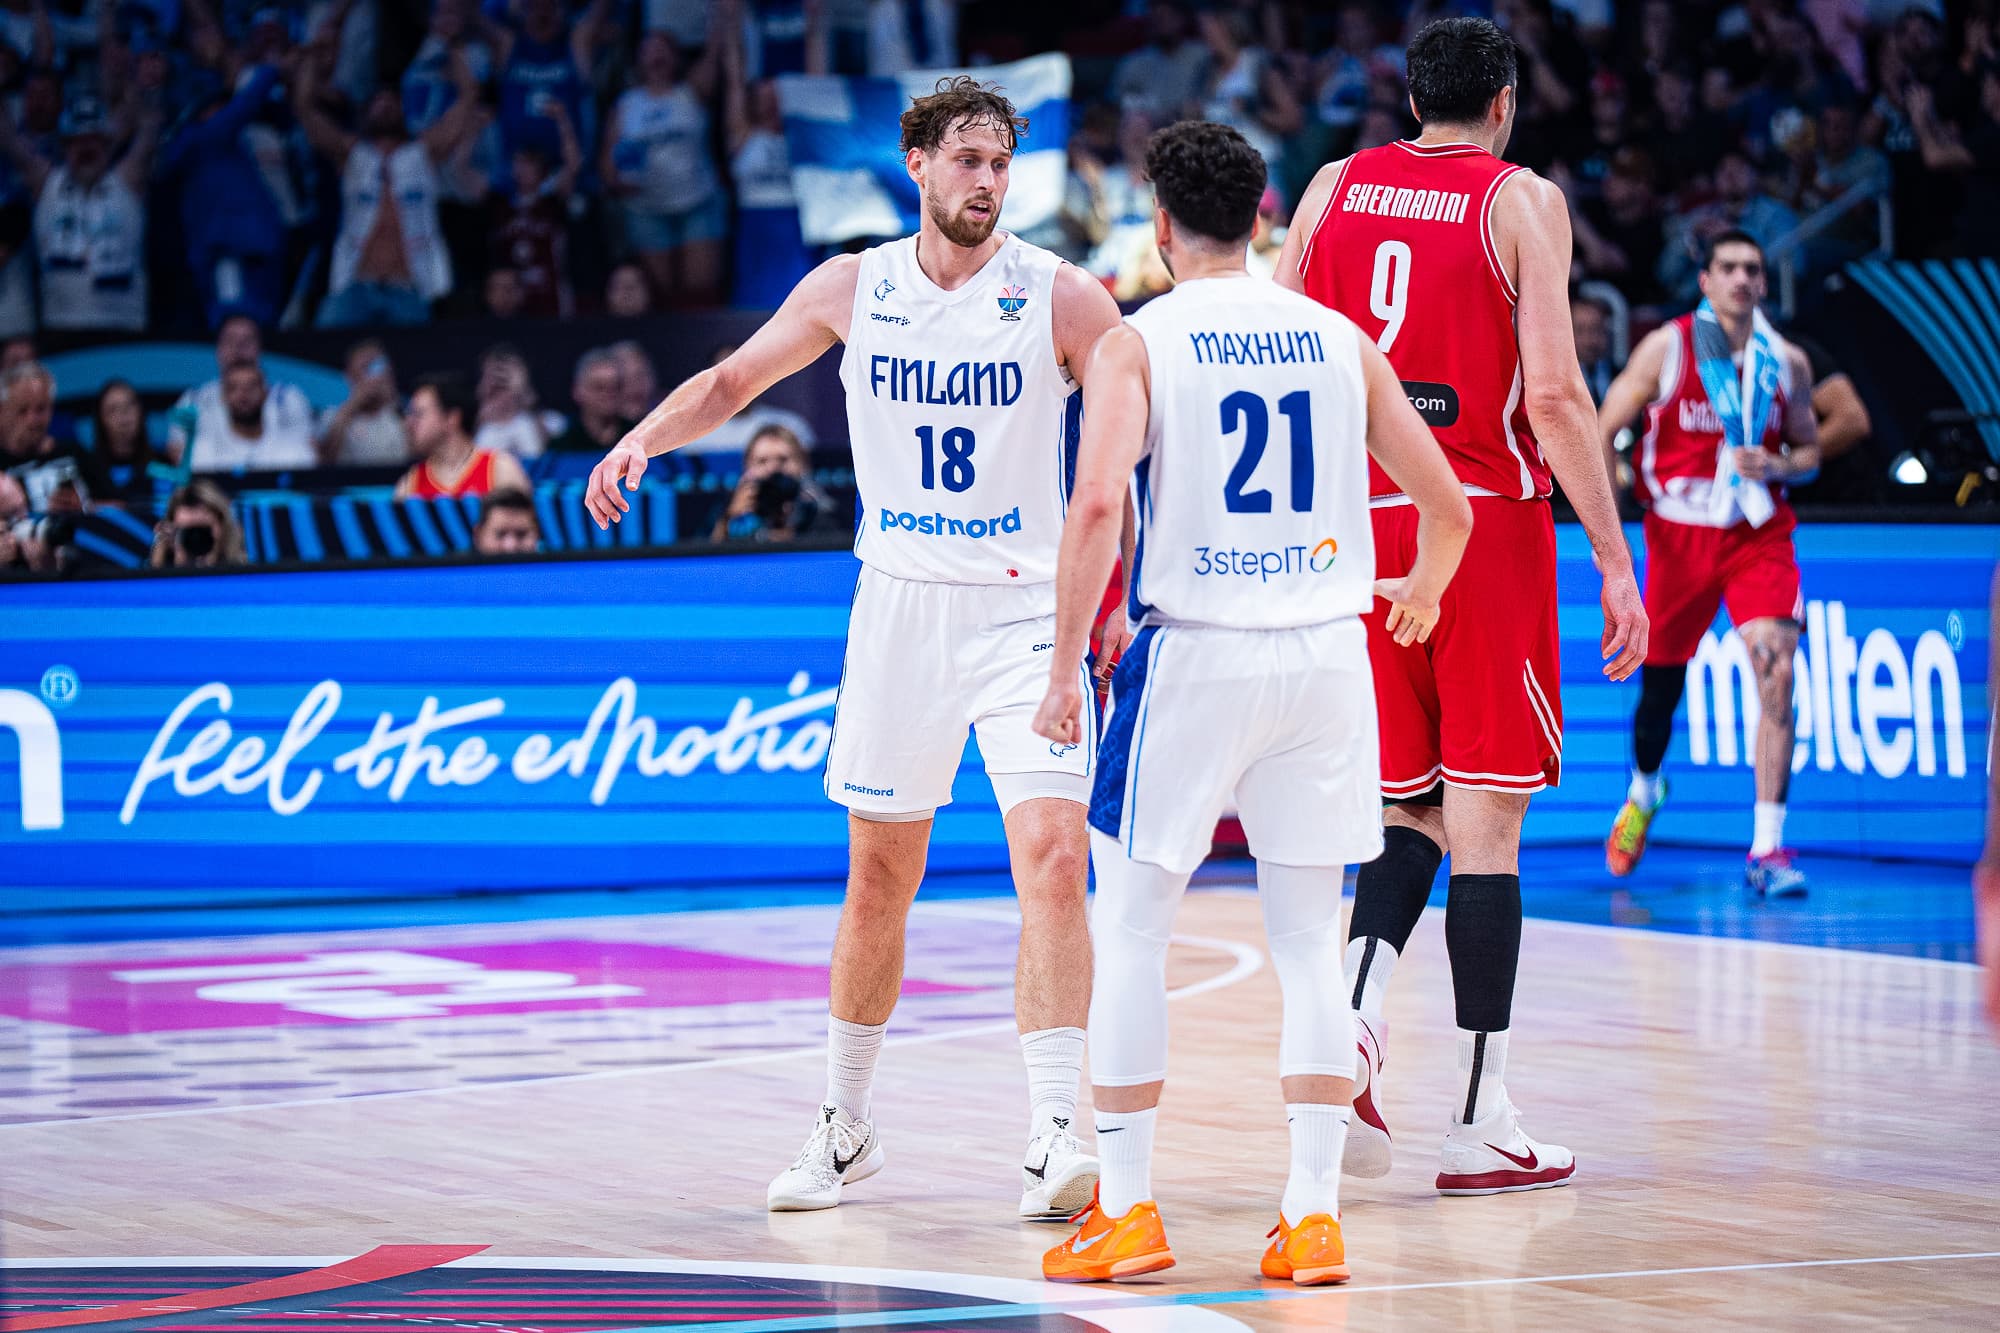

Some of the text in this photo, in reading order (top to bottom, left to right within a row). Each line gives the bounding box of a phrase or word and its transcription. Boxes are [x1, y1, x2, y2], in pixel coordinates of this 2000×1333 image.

[1342, 183, 1471, 224] SHERMADINI
[870, 313, 902, 325] CRAFT
[1369, 239, 1412, 353] 9
[1189, 331, 1325, 365] MAXHUNI
[870, 354, 1023, 407] FINLAND
[914, 425, 976, 493] 18
[1219, 389, 1315, 513] 21
[880, 506, 1022, 538] postnord
[118, 679, 343, 826] feel
[332, 695, 506, 803] the
[843, 782, 894, 797] postnord
